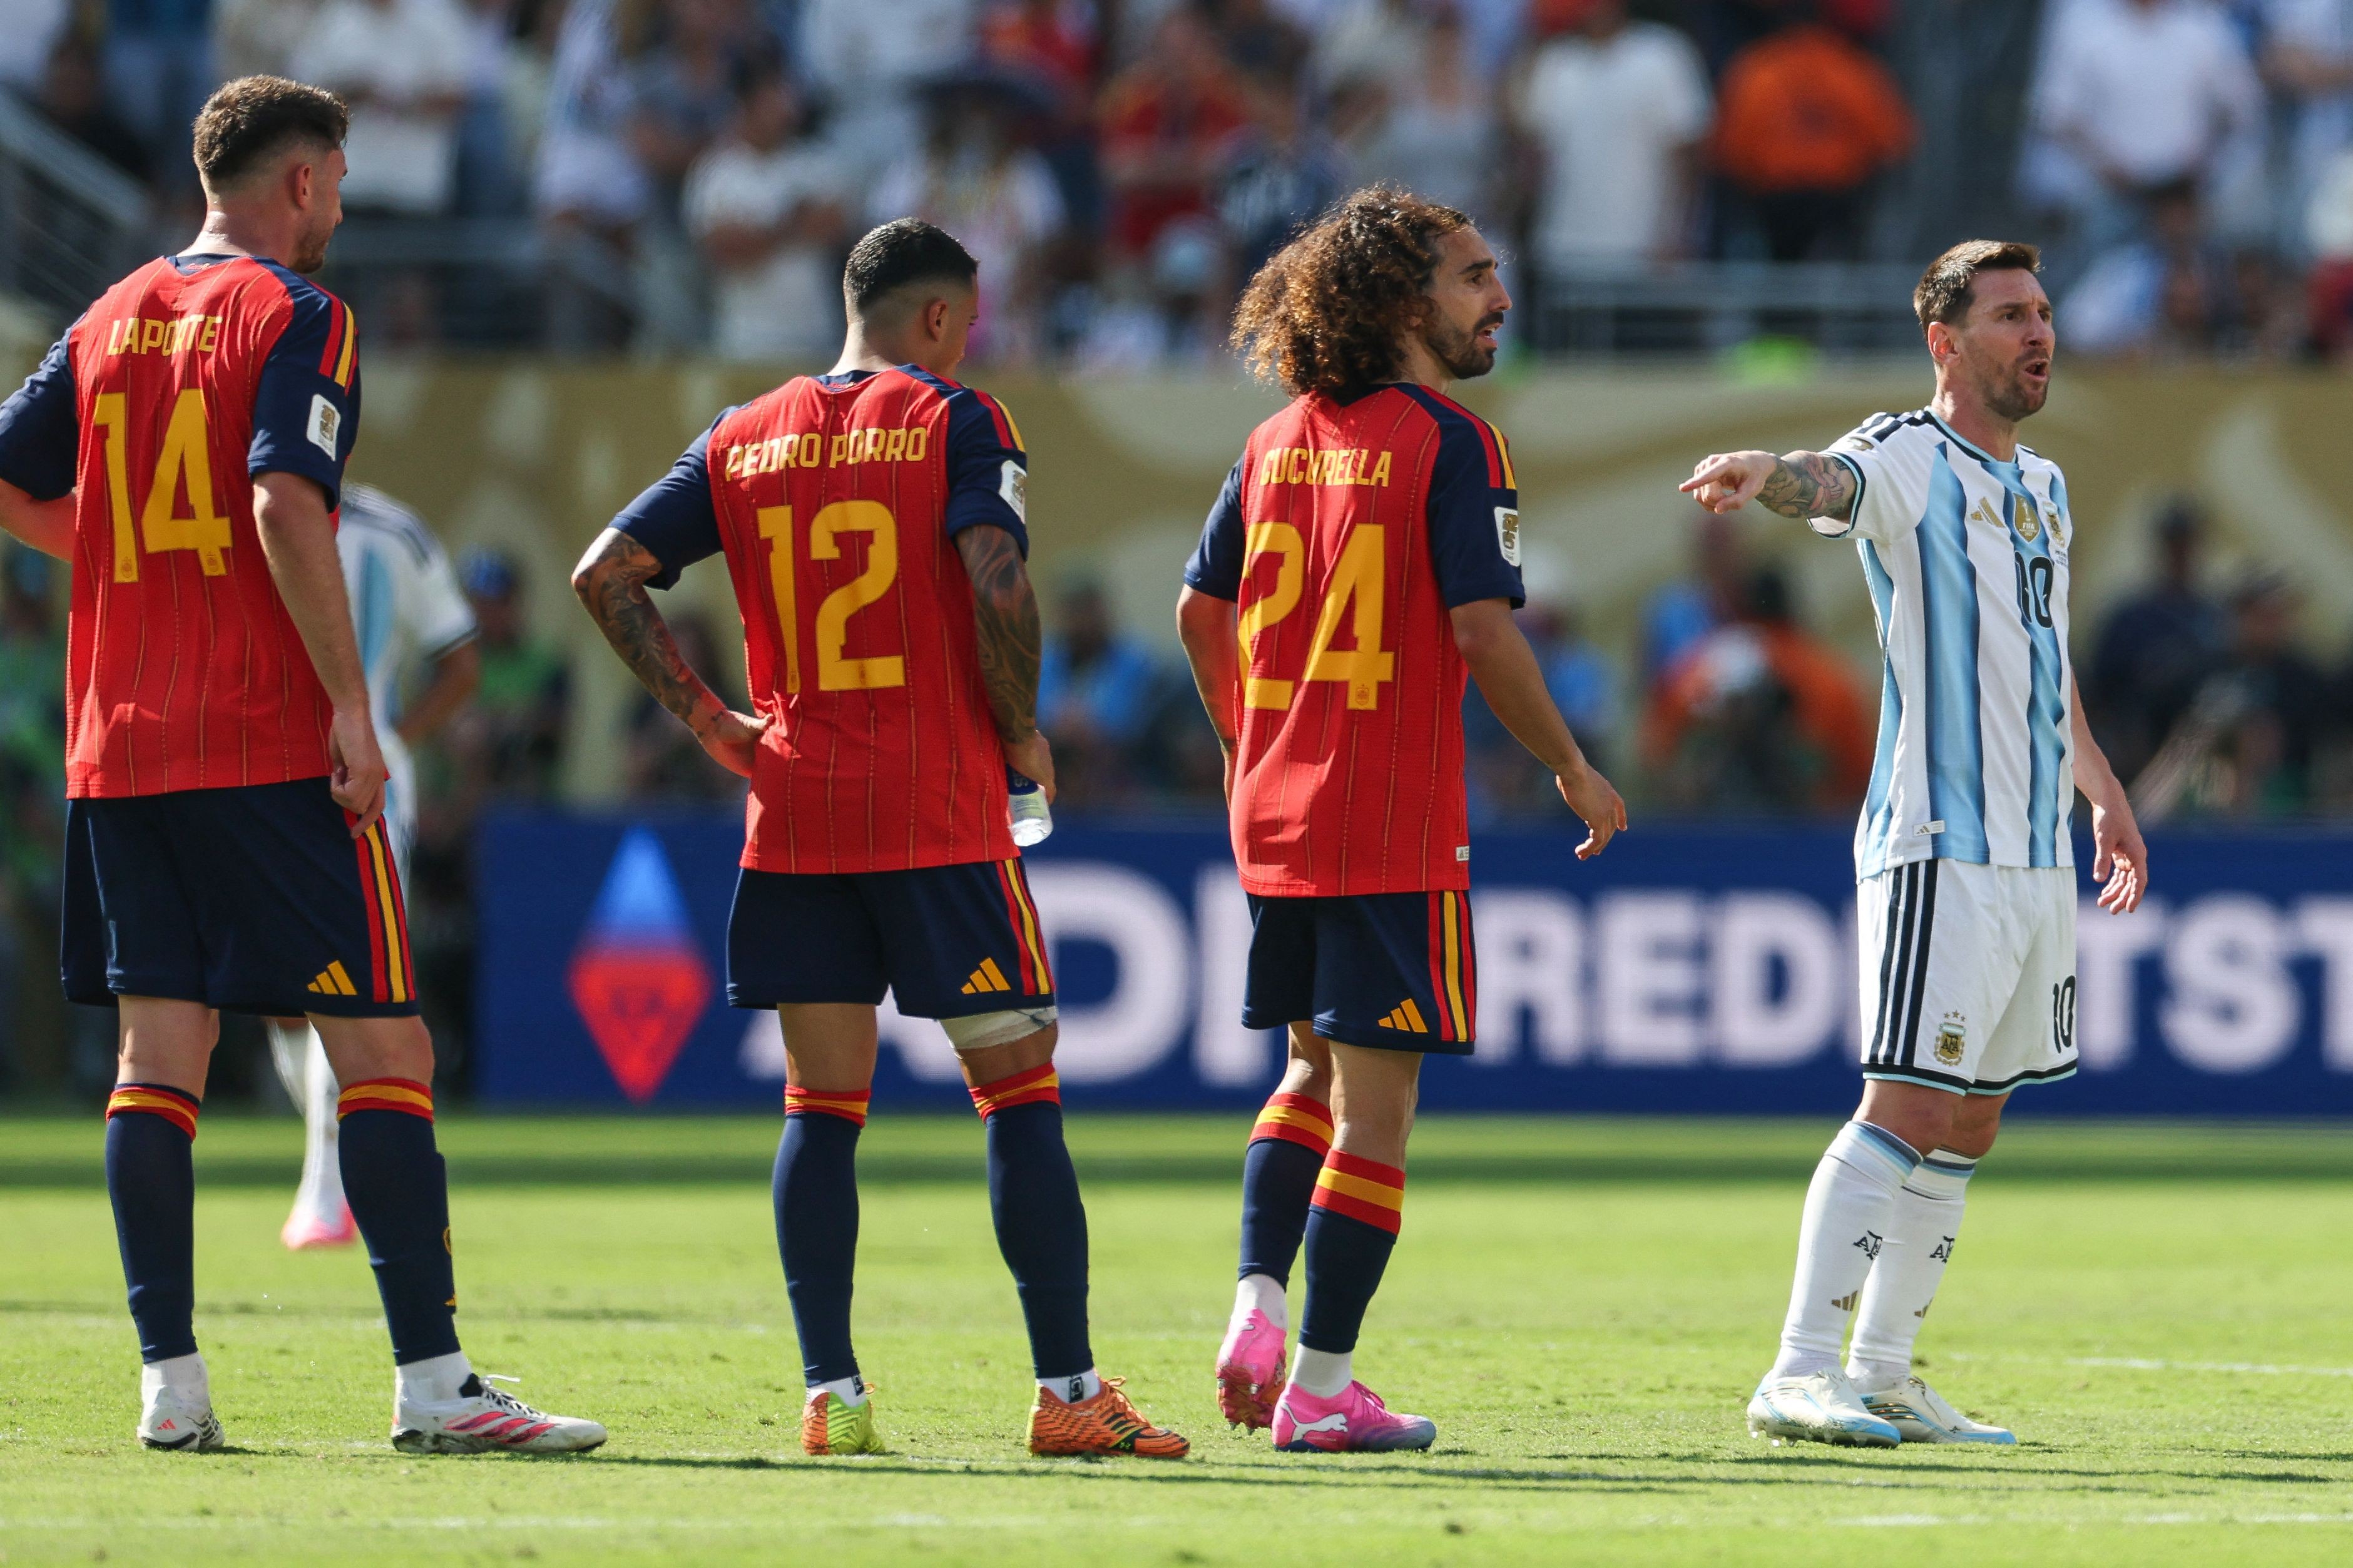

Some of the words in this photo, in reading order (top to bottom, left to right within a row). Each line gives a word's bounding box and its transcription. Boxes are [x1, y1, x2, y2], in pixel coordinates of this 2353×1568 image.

[94, 389, 233, 584] 14
[725, 433, 821, 481] PEDRO
[829, 427, 926, 469] PORRO
[1260, 447, 1392, 487] CUCURELLA
[757, 499, 906, 695] 12
[1238, 521, 1394, 710] 24
[2014, 551, 2053, 628] 10
[2053, 975, 2076, 1054] 10
